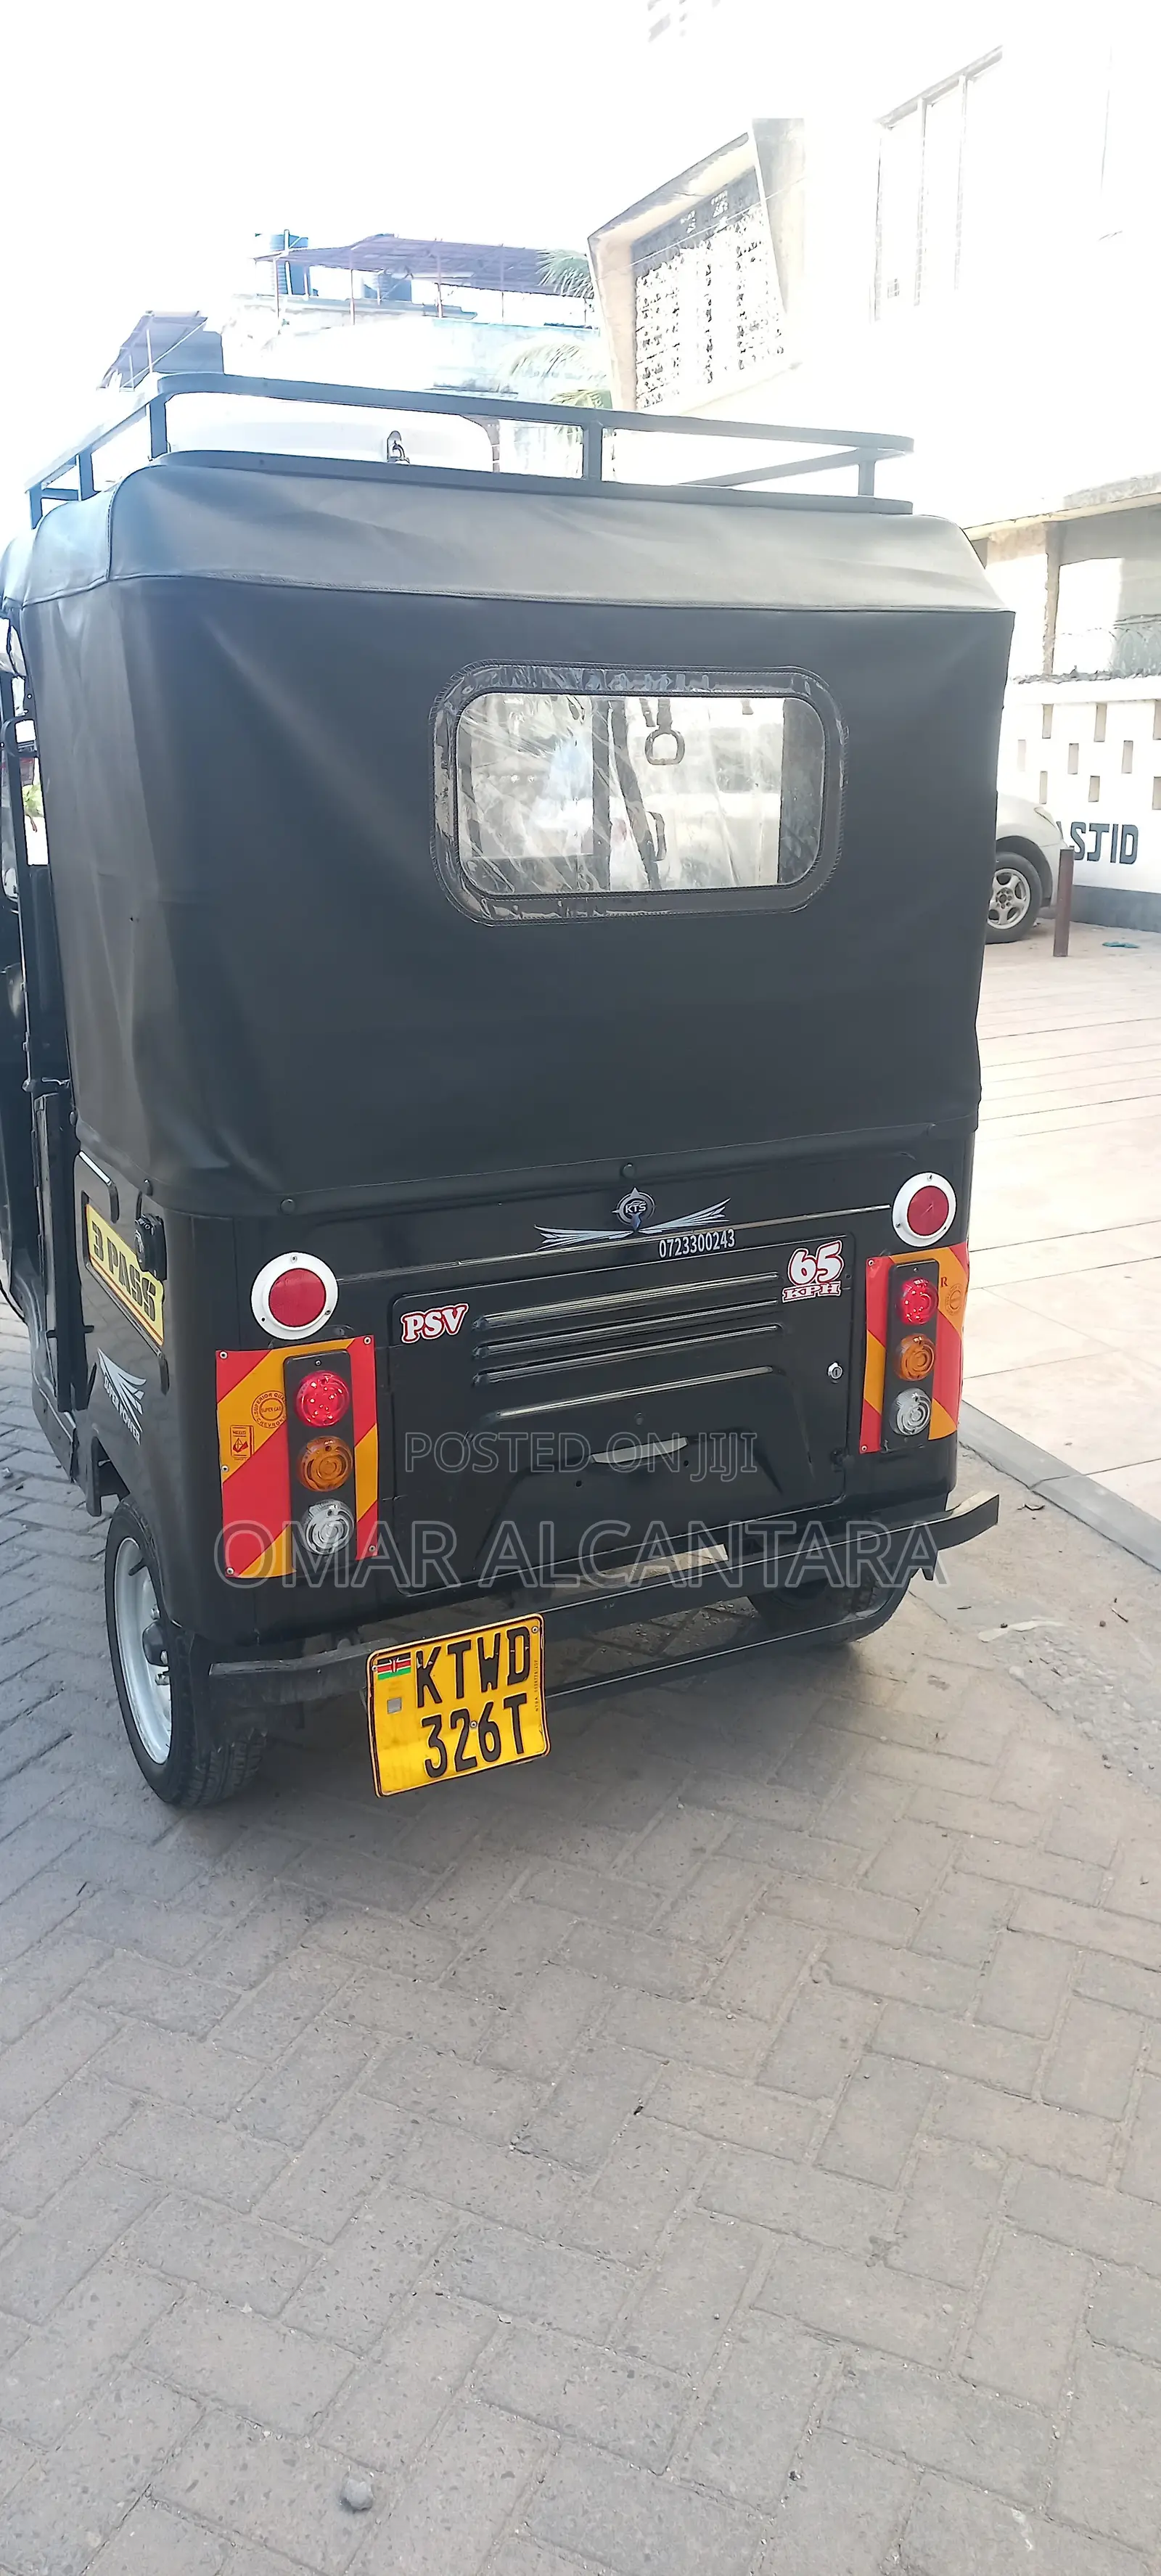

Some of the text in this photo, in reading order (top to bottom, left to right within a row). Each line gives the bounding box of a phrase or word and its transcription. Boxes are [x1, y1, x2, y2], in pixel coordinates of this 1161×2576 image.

[625, 1202, 647, 1213] KTS
[659, 1228, 735, 1258] 0723300243
[92, 1221, 156, 1322] 3 PASS
[789, 1240, 844, 1285] 65
[783, 1283, 840, 1302] KPH
[402, 1305, 467, 1342] PSV
[253, 1392, 273, 1418] SUPERIOR
[416, 1626, 530, 1708] KTWD
[421, 1692, 528, 1779] 326T
